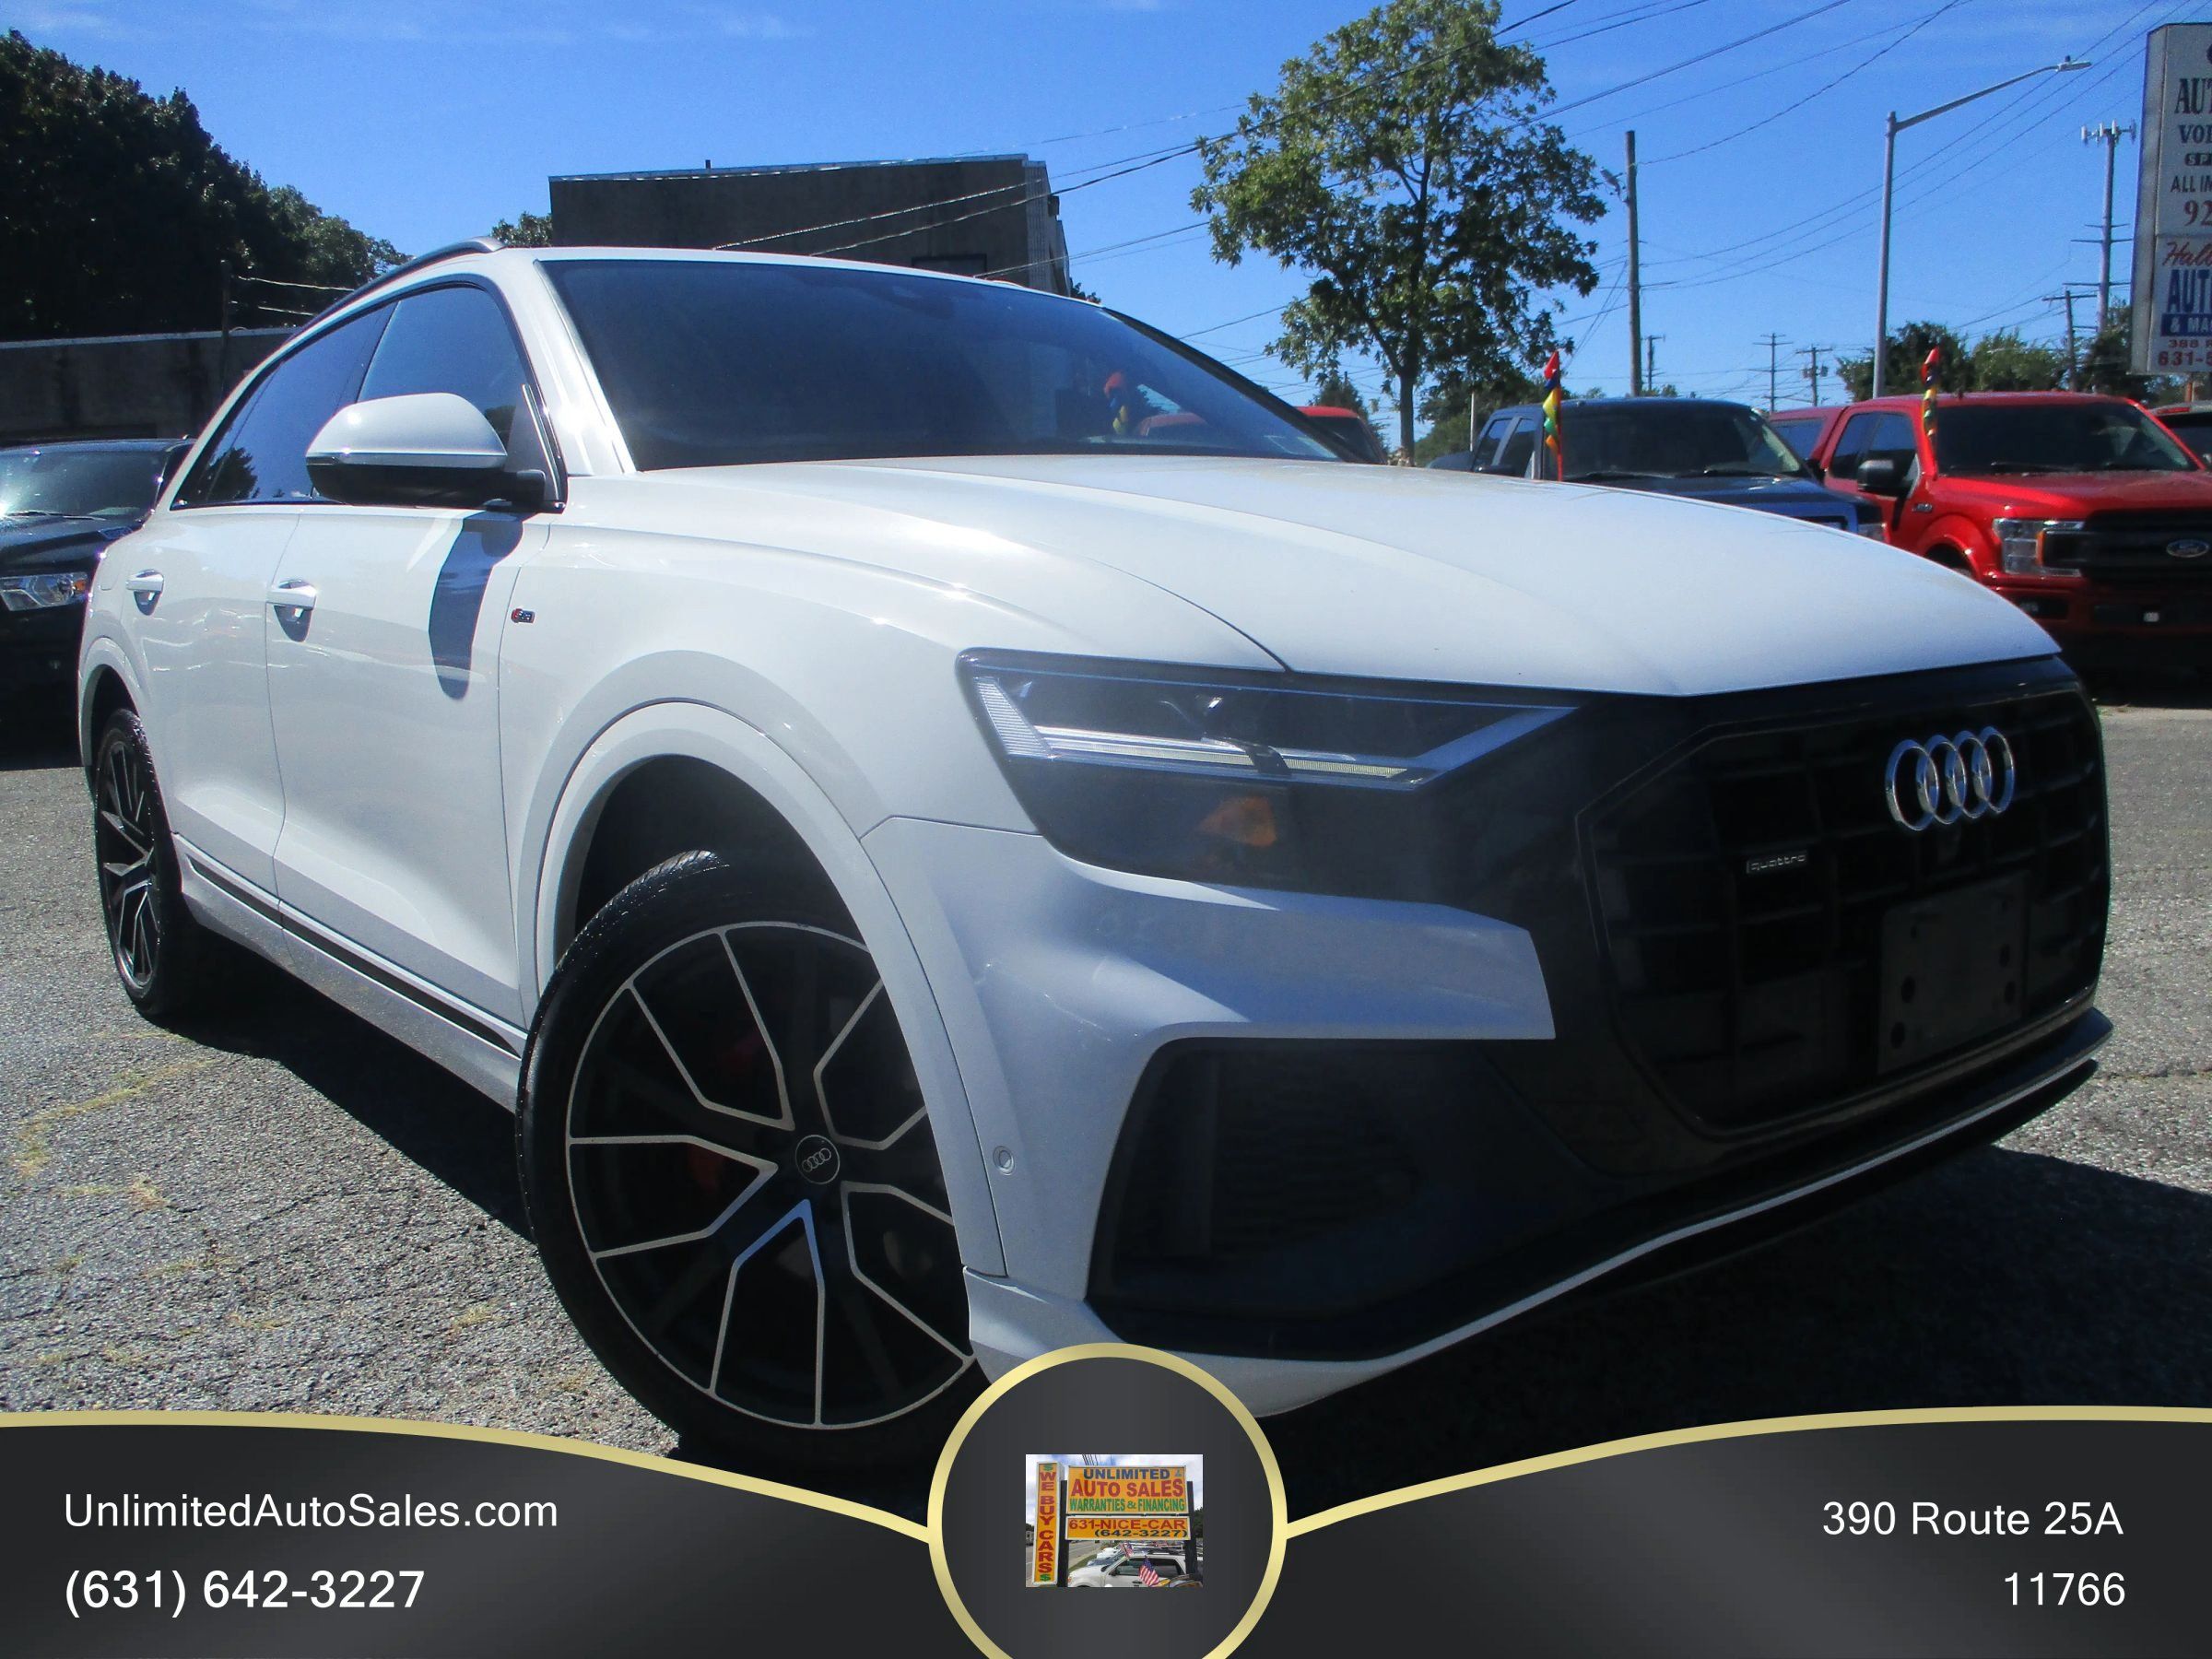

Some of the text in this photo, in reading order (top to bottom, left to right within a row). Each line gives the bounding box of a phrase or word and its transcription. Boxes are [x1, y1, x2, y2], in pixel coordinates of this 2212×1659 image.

[2171, 175, 2195, 193] ALL
[2167, 269, 2212, 312] AUT
[2187, 317, 2212, 333] MA
